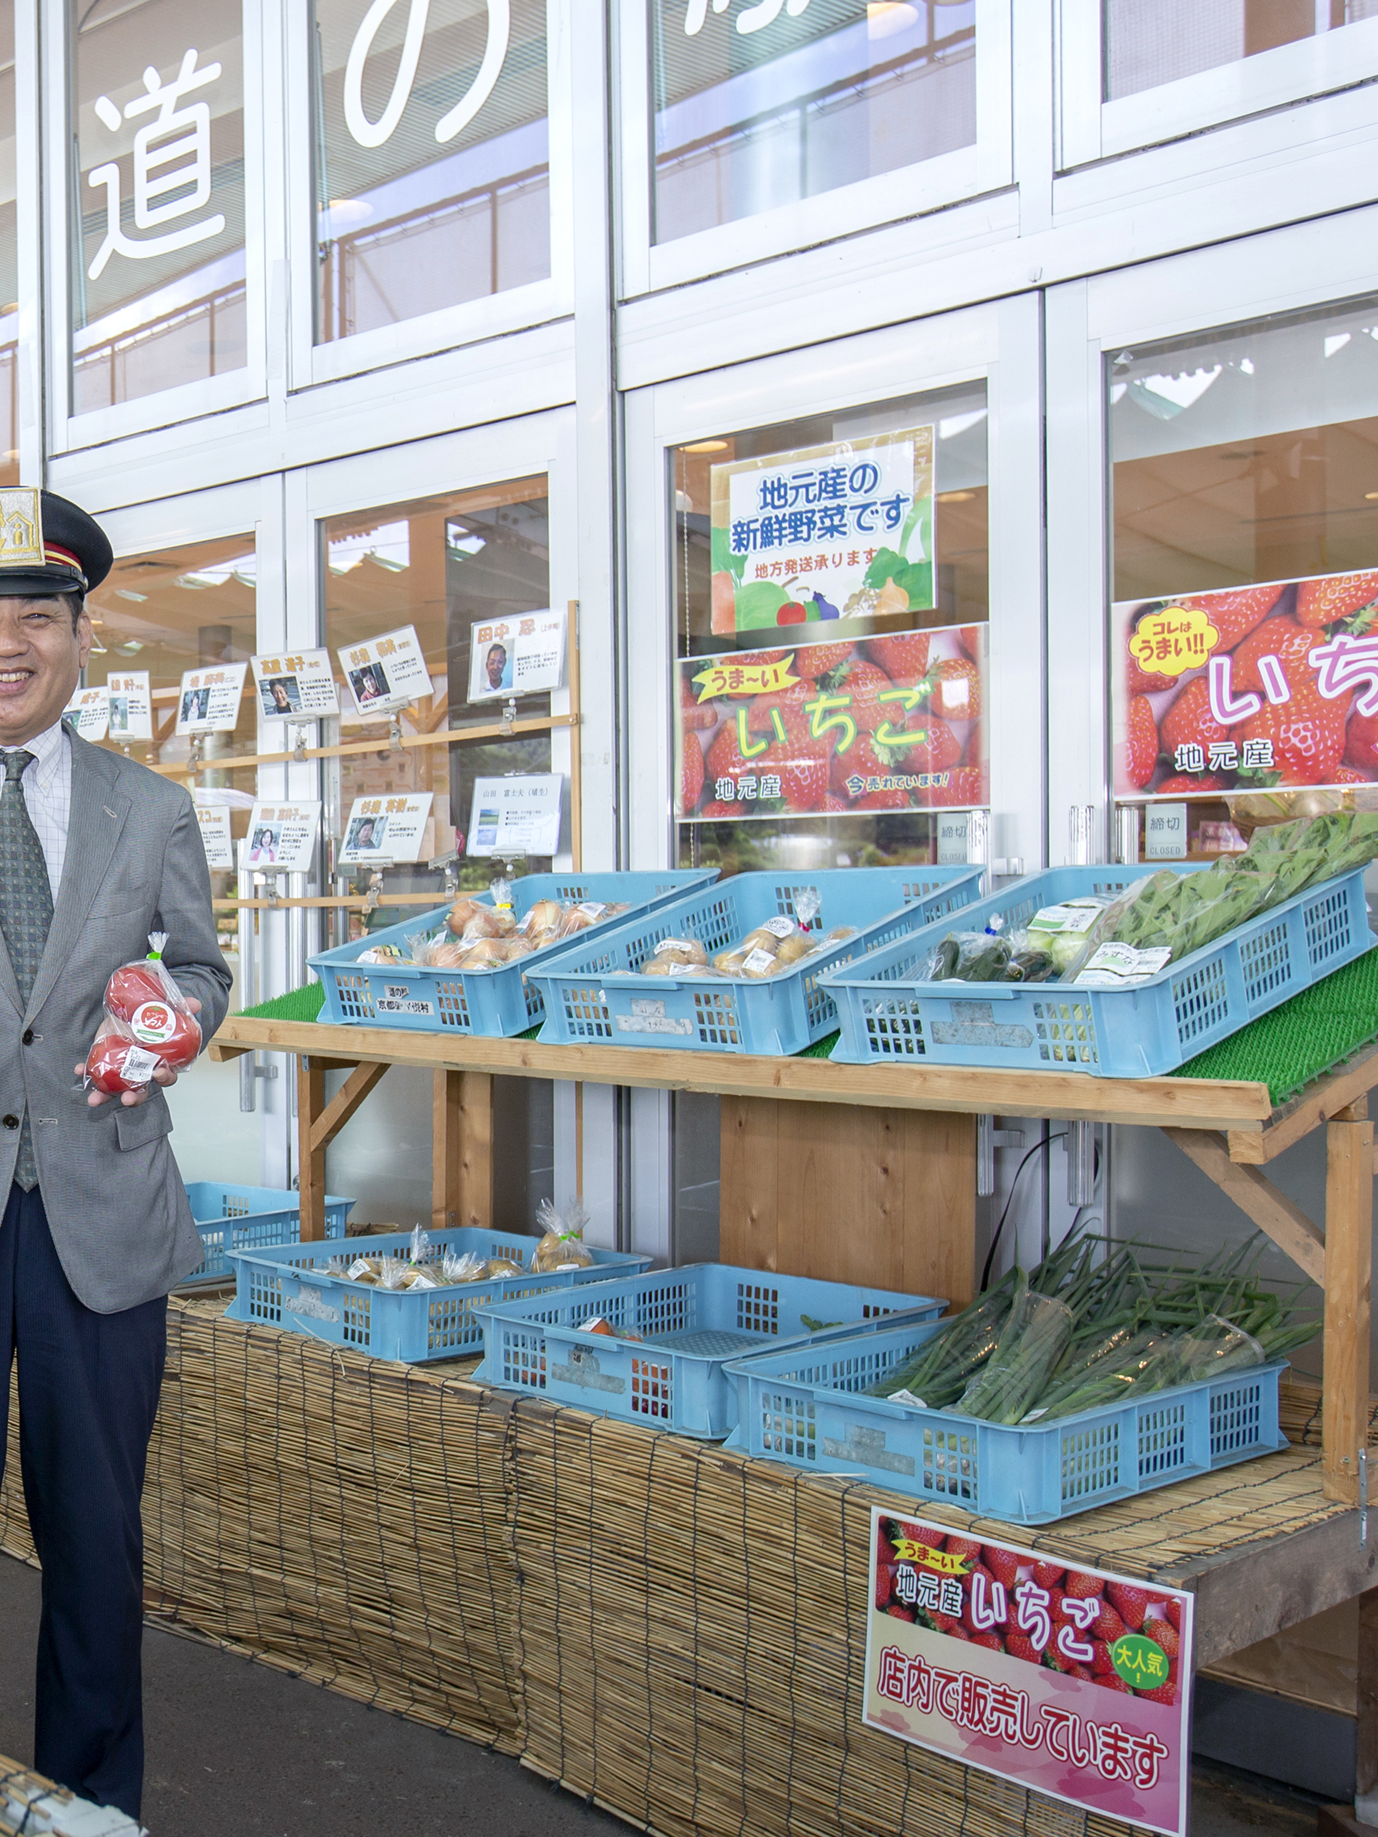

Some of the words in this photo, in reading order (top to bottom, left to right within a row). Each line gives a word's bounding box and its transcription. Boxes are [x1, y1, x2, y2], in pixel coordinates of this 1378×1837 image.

[759, 463, 879, 510] 地元産の
[731, 493, 910, 553] 新鮮野菜です
[755, 548, 878, 579] 地方発送承ります
[478, 623, 509, 644] 田中
[1153, 621, 1192, 636] コレは
[1138, 633, 1205, 663] うまい!!
[736, 680, 935, 760] いちご
[1174, 738, 1275, 772] 地元産
[715, 774, 782, 800] 地元産
[846, 772, 951, 795] 今売れています!
[941, 825, 967, 839] 締切
[1150, 817, 1180, 831] 締切
[1150, 846, 1181, 855] CLOSED
[896, 1564, 963, 1618] 地元産
[972, 1571, 1100, 1662] いちご
[1116, 1645, 1163, 1678] 大人気
[878, 1645, 1169, 1789] 店内で販売しています
